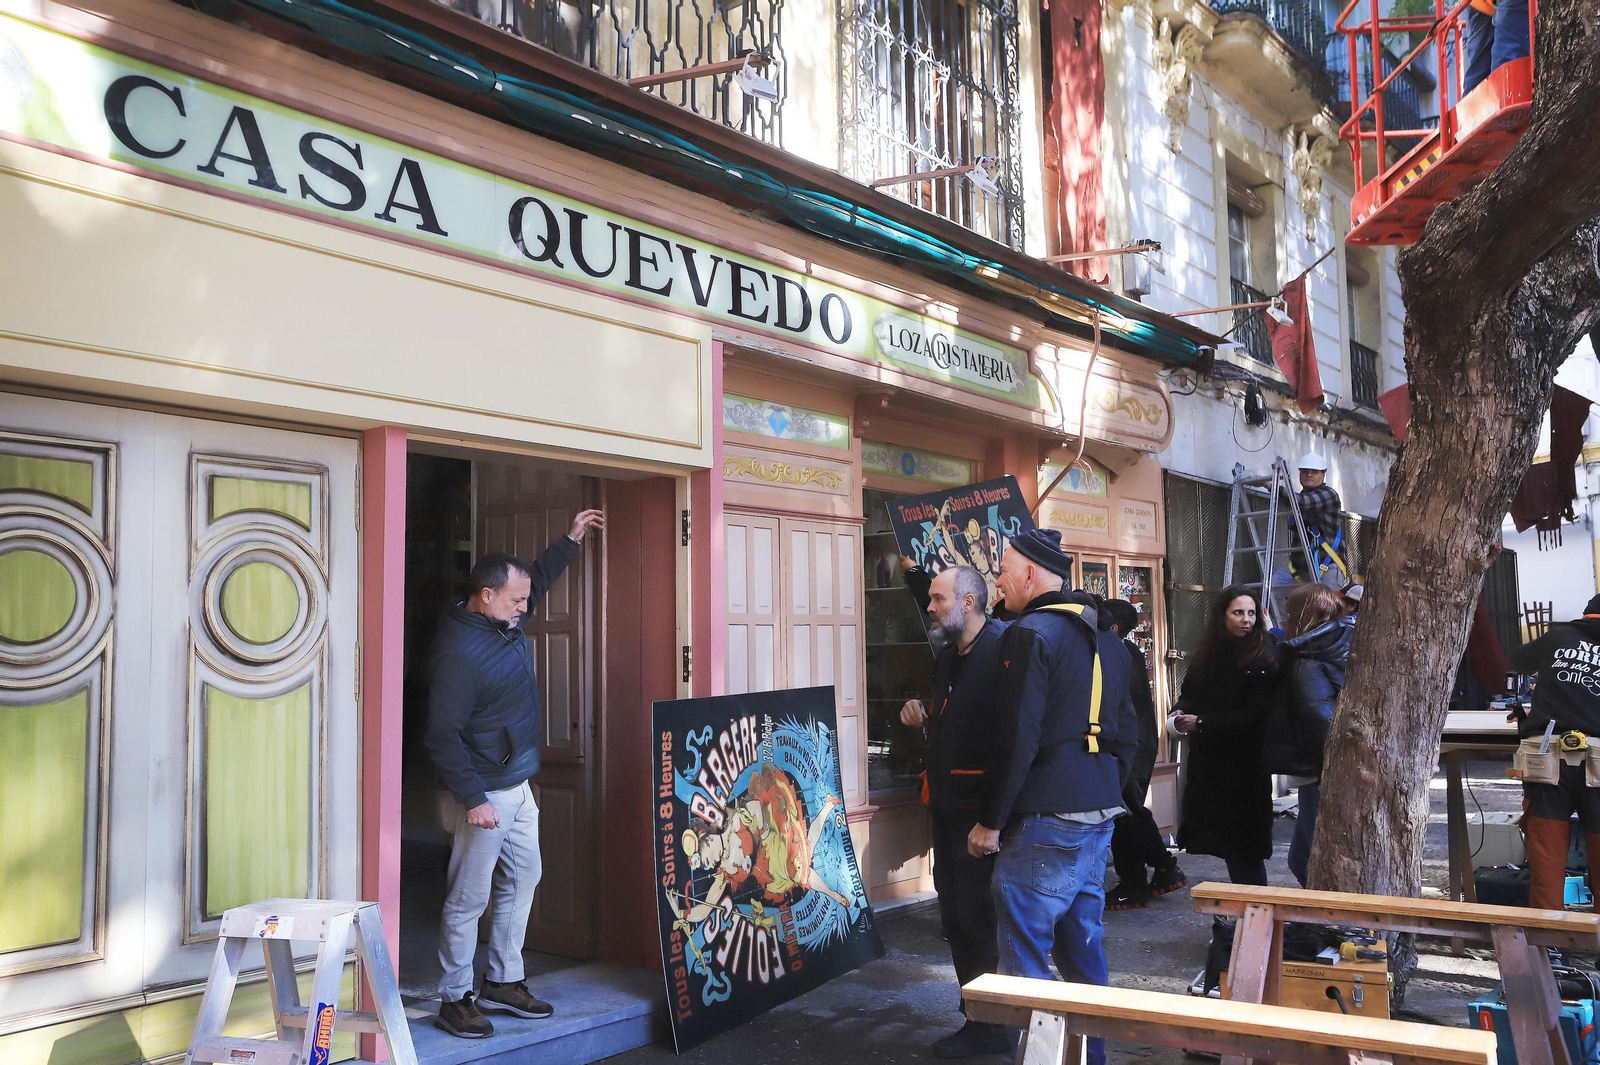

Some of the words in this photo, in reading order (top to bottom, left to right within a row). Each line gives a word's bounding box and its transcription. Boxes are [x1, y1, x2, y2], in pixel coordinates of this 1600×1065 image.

[104, 75, 448, 237] CASA
[508, 196, 853, 345] QUEVEDO
[889, 324, 932, 359] LOZA
[898, 505, 923, 523] Tous
[921, 502, 936, 518] les
[948, 495, 972, 513] Soirs
[973, 491, 984, 507] 8
[982, 486, 1011, 504] Heures
[761, 713, 774, 741] Richer
[660, 730, 673, 798] Heures
[762, 749, 774, 763] 32
[784, 751, 808, 779] BALLETS
[660, 801, 674, 819] 8
[662, 834, 676, 888] Soirs
[841, 829, 858, 872] UNIQUE
[851, 873, 864, 898] PRIX
[669, 929, 684, 964] les
[703, 895, 786, 984] FOLIES
[674, 964, 693, 1025] Tous
[316, 1006, 334, 1050] RHINO
